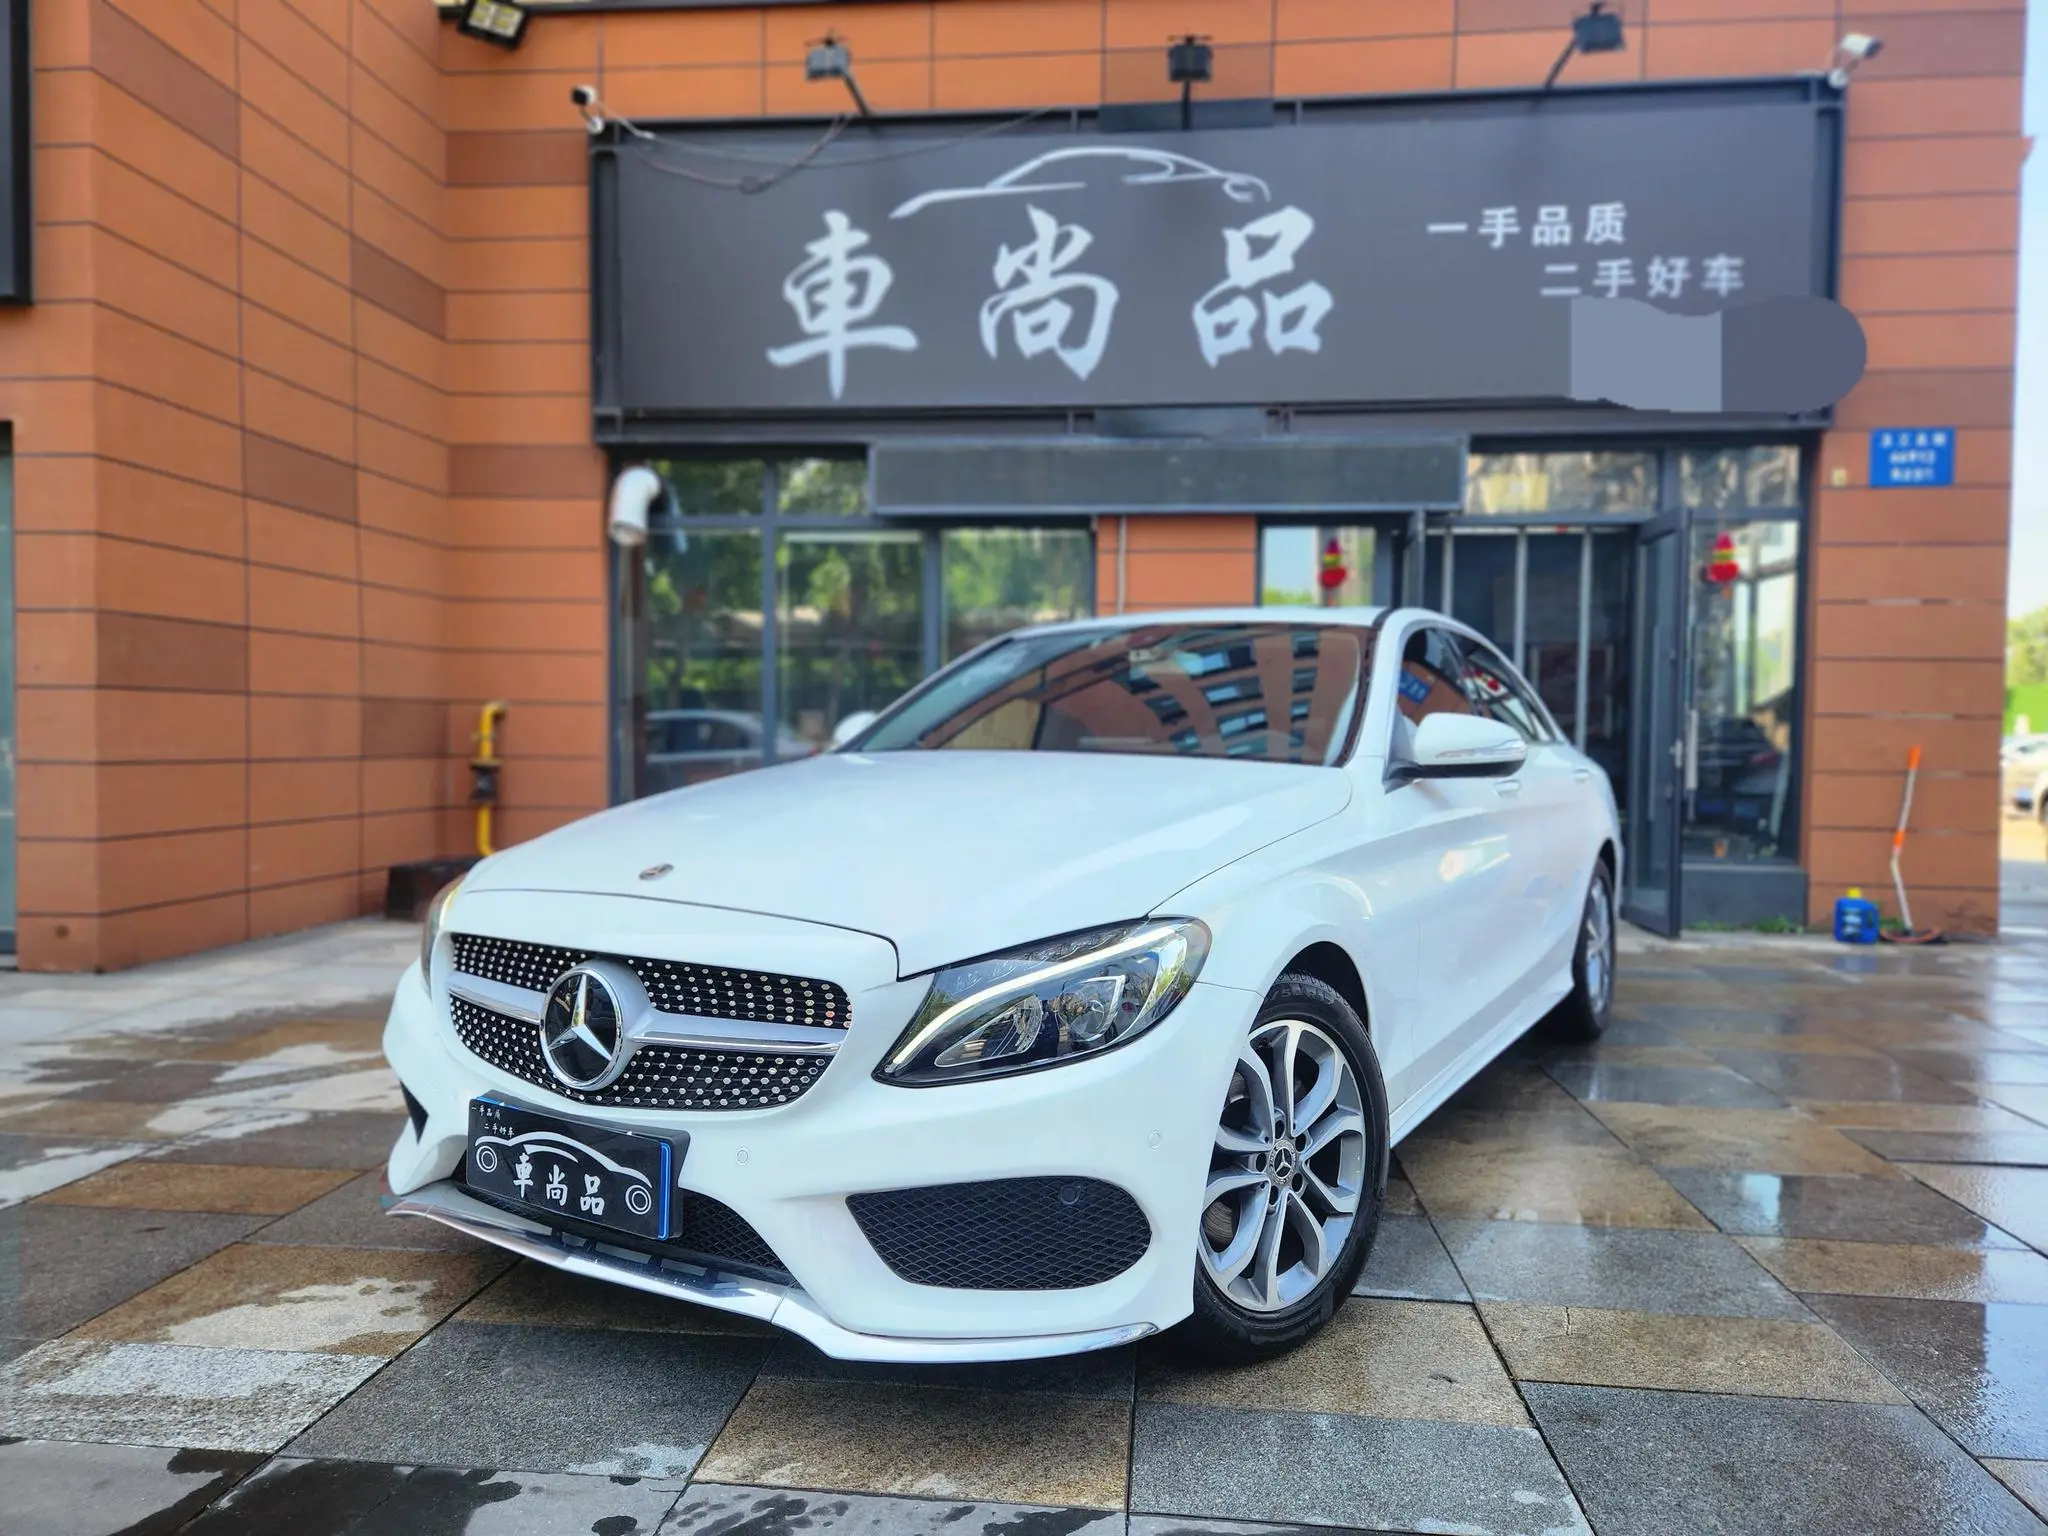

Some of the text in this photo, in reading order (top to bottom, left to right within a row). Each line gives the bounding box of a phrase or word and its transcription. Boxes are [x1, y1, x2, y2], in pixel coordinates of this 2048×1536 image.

[1426, 202, 1629, 248] 一手品质
[766, 202, 1335, 401] 車尚品
[1540, 253, 1746, 299] 二手好车
[513, 1152, 605, 1216] 車尚品
